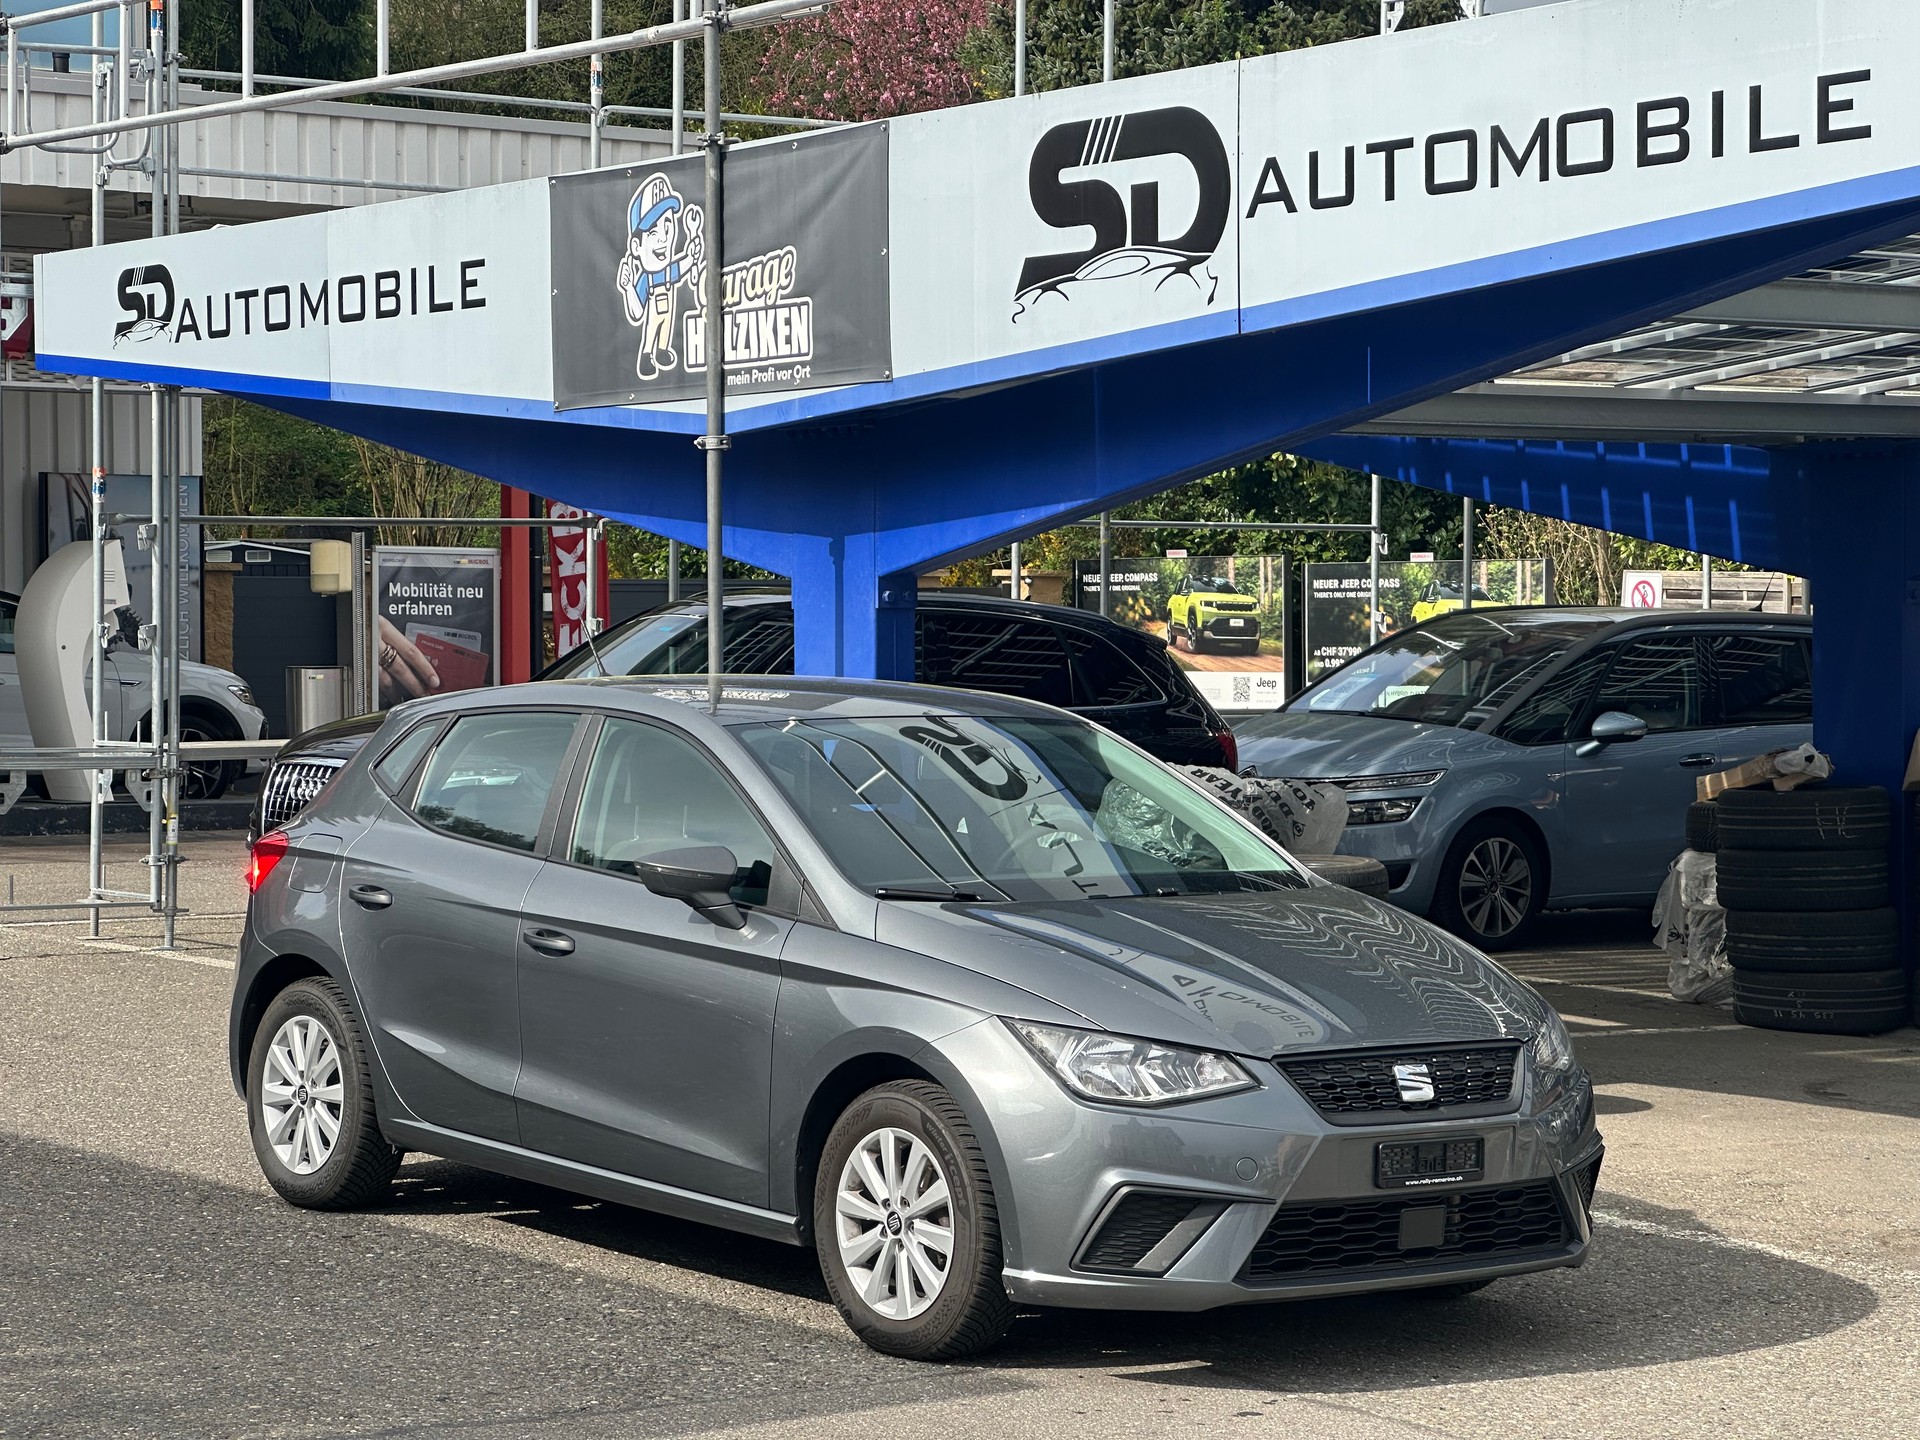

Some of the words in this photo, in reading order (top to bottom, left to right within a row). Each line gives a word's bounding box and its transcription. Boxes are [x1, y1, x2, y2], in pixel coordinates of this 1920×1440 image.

[1013, 106, 1231, 302] SD
[1245, 69, 1872, 218] AUTOMOBILE
[114, 263, 176, 340] SD
[175, 258, 487, 343] AUTOMOBILE
[687, 304, 809, 365] HLZIKEN
[727, 371, 750, 386] mein
[751, 367, 774, 384] Profi
[776, 369, 792, 382] vor
[1083, 574, 1101, 583] NEUE
[1124, 573, 1158, 583] COMPASS
[1313, 579, 1339, 589] NEUER
[1361, 578, 1400, 588] COPASS
[388, 582, 453, 598] Mobilität
[457, 586, 483, 598] neu
[388, 600, 453, 616] erfahren
[1321, 647, 1337, 656] CHF
[1257, 677, 1277, 689] Jeep
